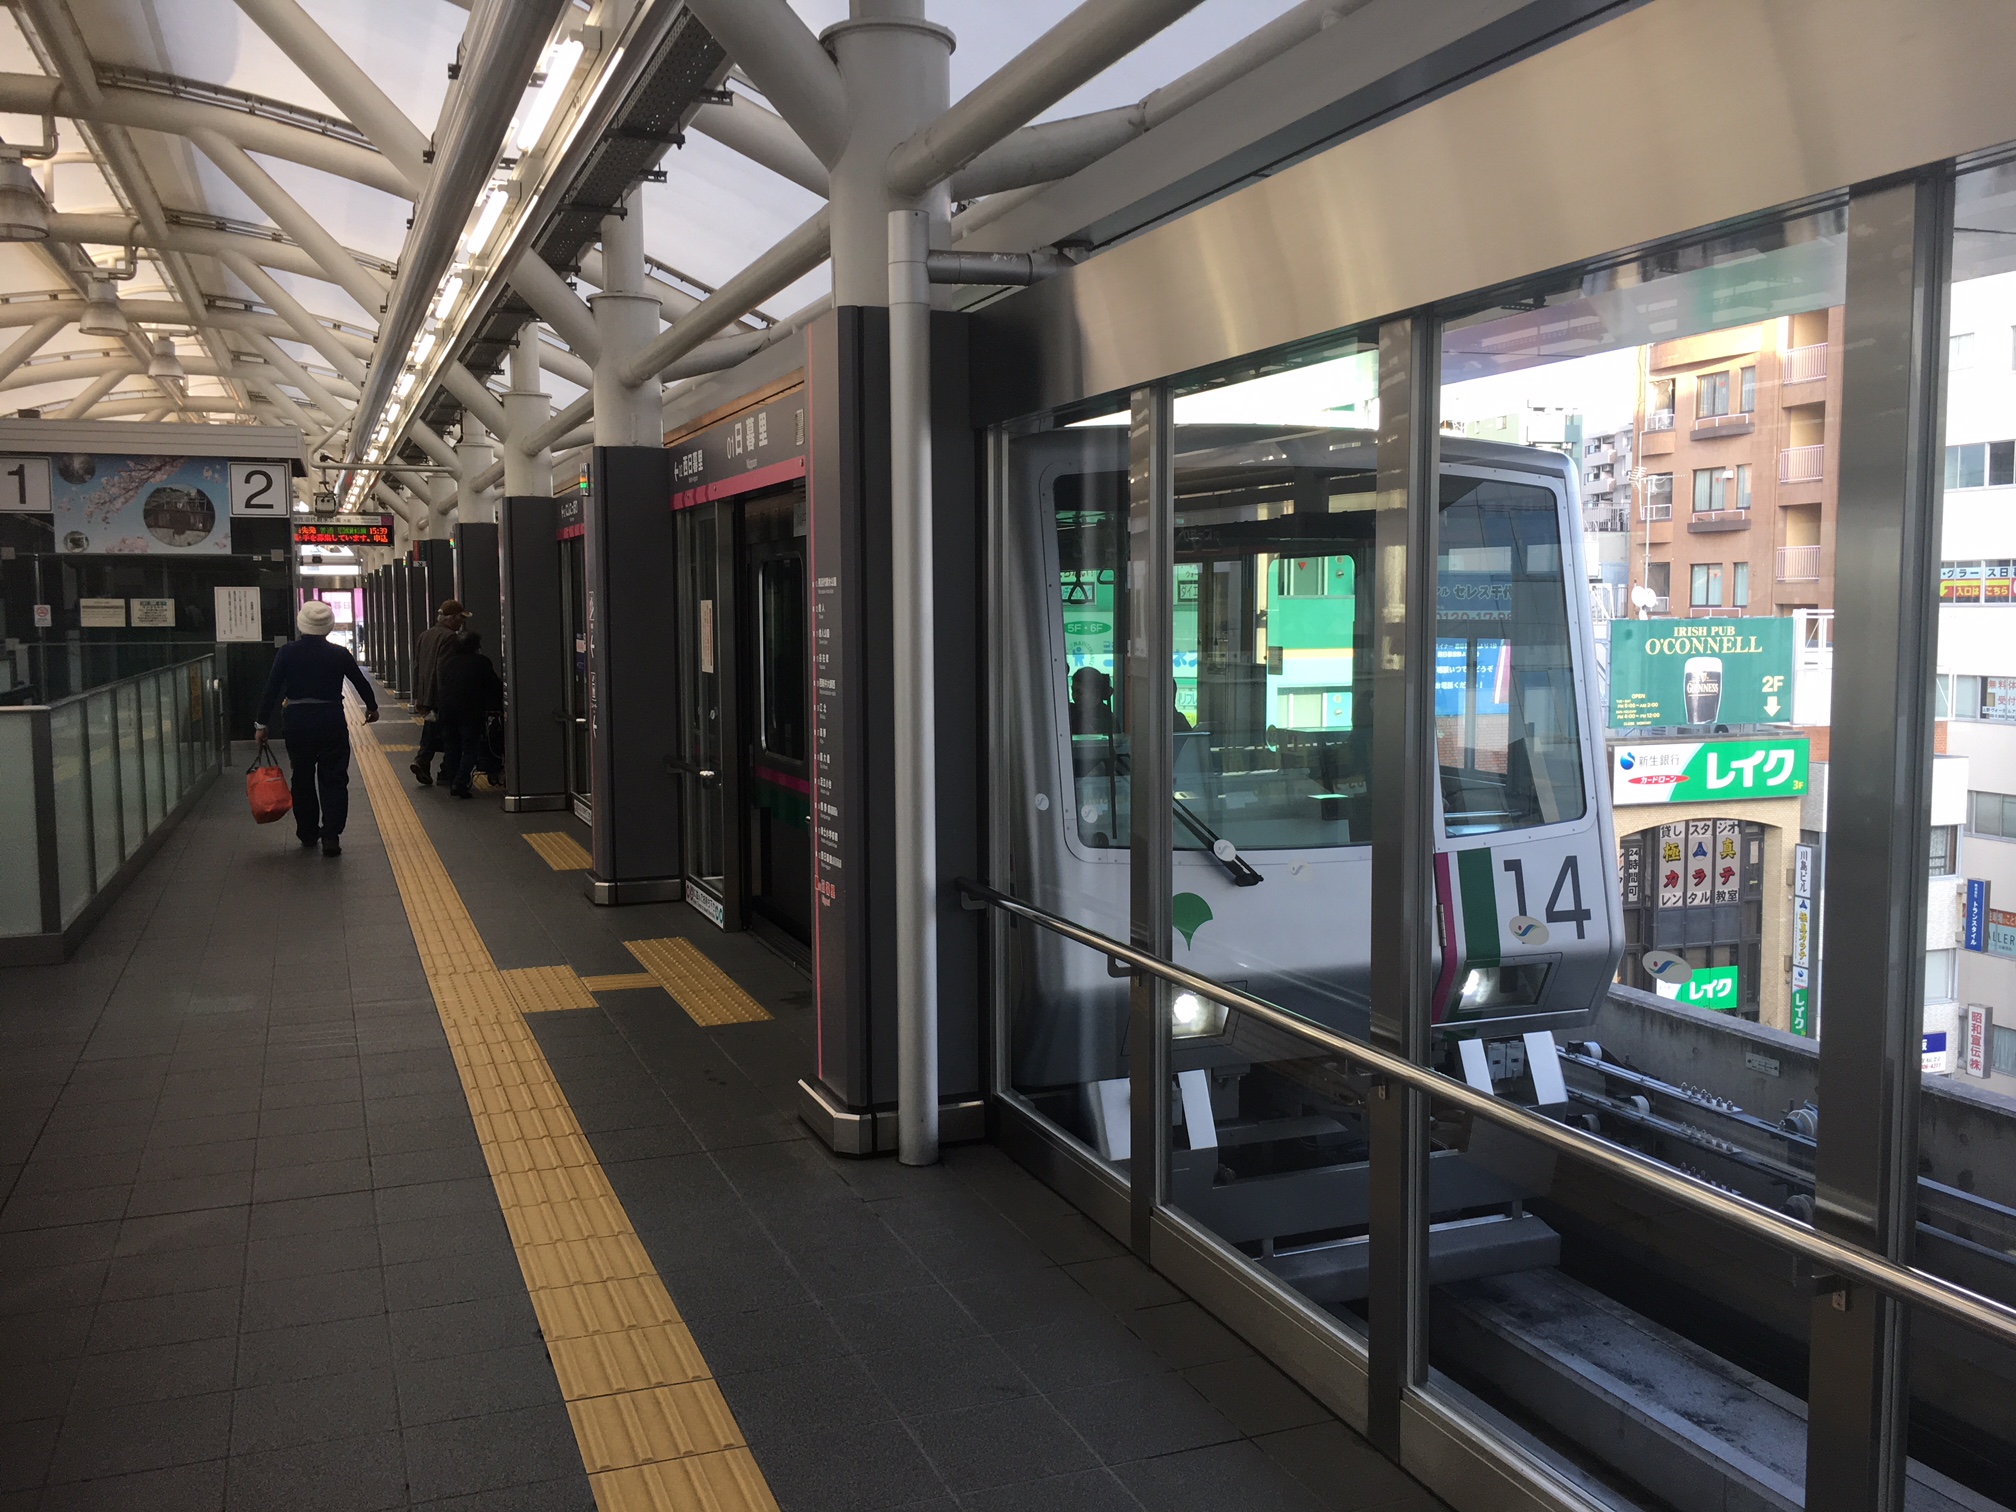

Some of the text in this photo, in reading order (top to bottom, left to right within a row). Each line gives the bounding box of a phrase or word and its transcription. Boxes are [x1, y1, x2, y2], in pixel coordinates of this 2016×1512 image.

[7, 463, 27, 505] 1
[243, 469, 275, 510] 2
[369, 527, 389, 535] 15:39
[1673, 625, 1736, 637] IRISH PUB
[1645, 636, 1764, 656] O'CONNELL
[1761, 675, 1785, 693] 2F
[1638, 754, 1680, 767] 新生銀行
[1706, 748, 1795, 790] レイク
[1639, 775, 1678, 785] カードローン
[1503, 855, 1592, 945] 14
[1689, 977, 1733, 1001] レイク
[1794, 993, 1805, 1030] レイク
